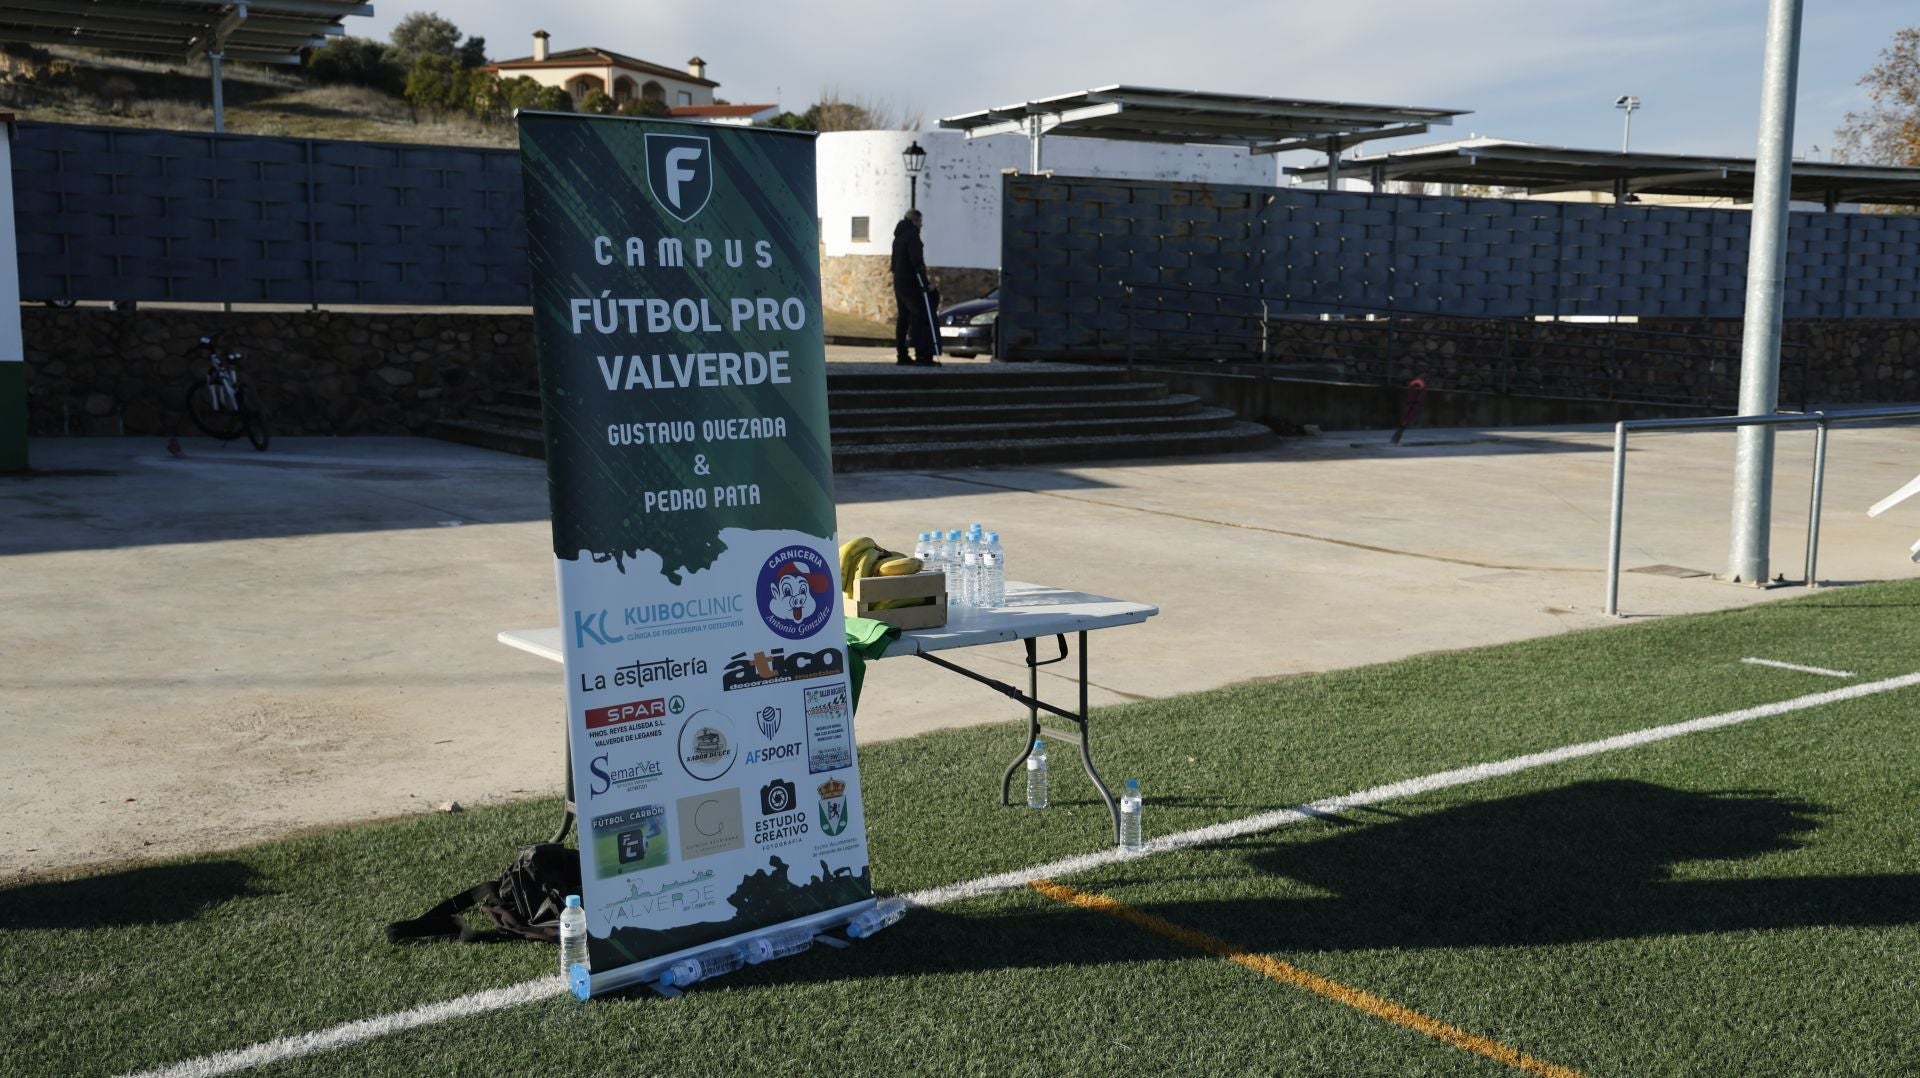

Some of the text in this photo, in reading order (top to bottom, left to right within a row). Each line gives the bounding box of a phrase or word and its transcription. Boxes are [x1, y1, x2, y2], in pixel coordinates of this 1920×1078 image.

[665, 146, 702, 210] F
[594, 235, 773, 269] CAMPUS
[570, 289, 806, 335] FÚTBOL PRO
[597, 350, 792, 391] VALVERDE
[607, 416, 787, 447] GUSTAVO QUEZADA
[693, 453, 711, 476] &
[644, 483, 761, 513] PEDRO PATA
[768, 549, 824, 569] CARNICERIA
[624, 594, 744, 626] KUIBOCLINIC
[765, 614, 797, 635] Antonio
[581, 656, 708, 693] La estantería
[729, 675, 792, 691] decoración
[607, 701, 665, 722] SPAR
[609, 724, 628, 735] REYES
[628, 720, 654, 732] ALISEDA
[595, 735, 625, 748] VALVERDE
[625, 734, 635, 742] DE
[744, 742, 803, 766] AFSPORT
[592, 815, 625, 829] FÚTBOL
[754, 823, 809, 844] CREATIVO
[755, 812, 807, 832] ESTUDIO
[602, 883, 715, 924] VALVERDE
